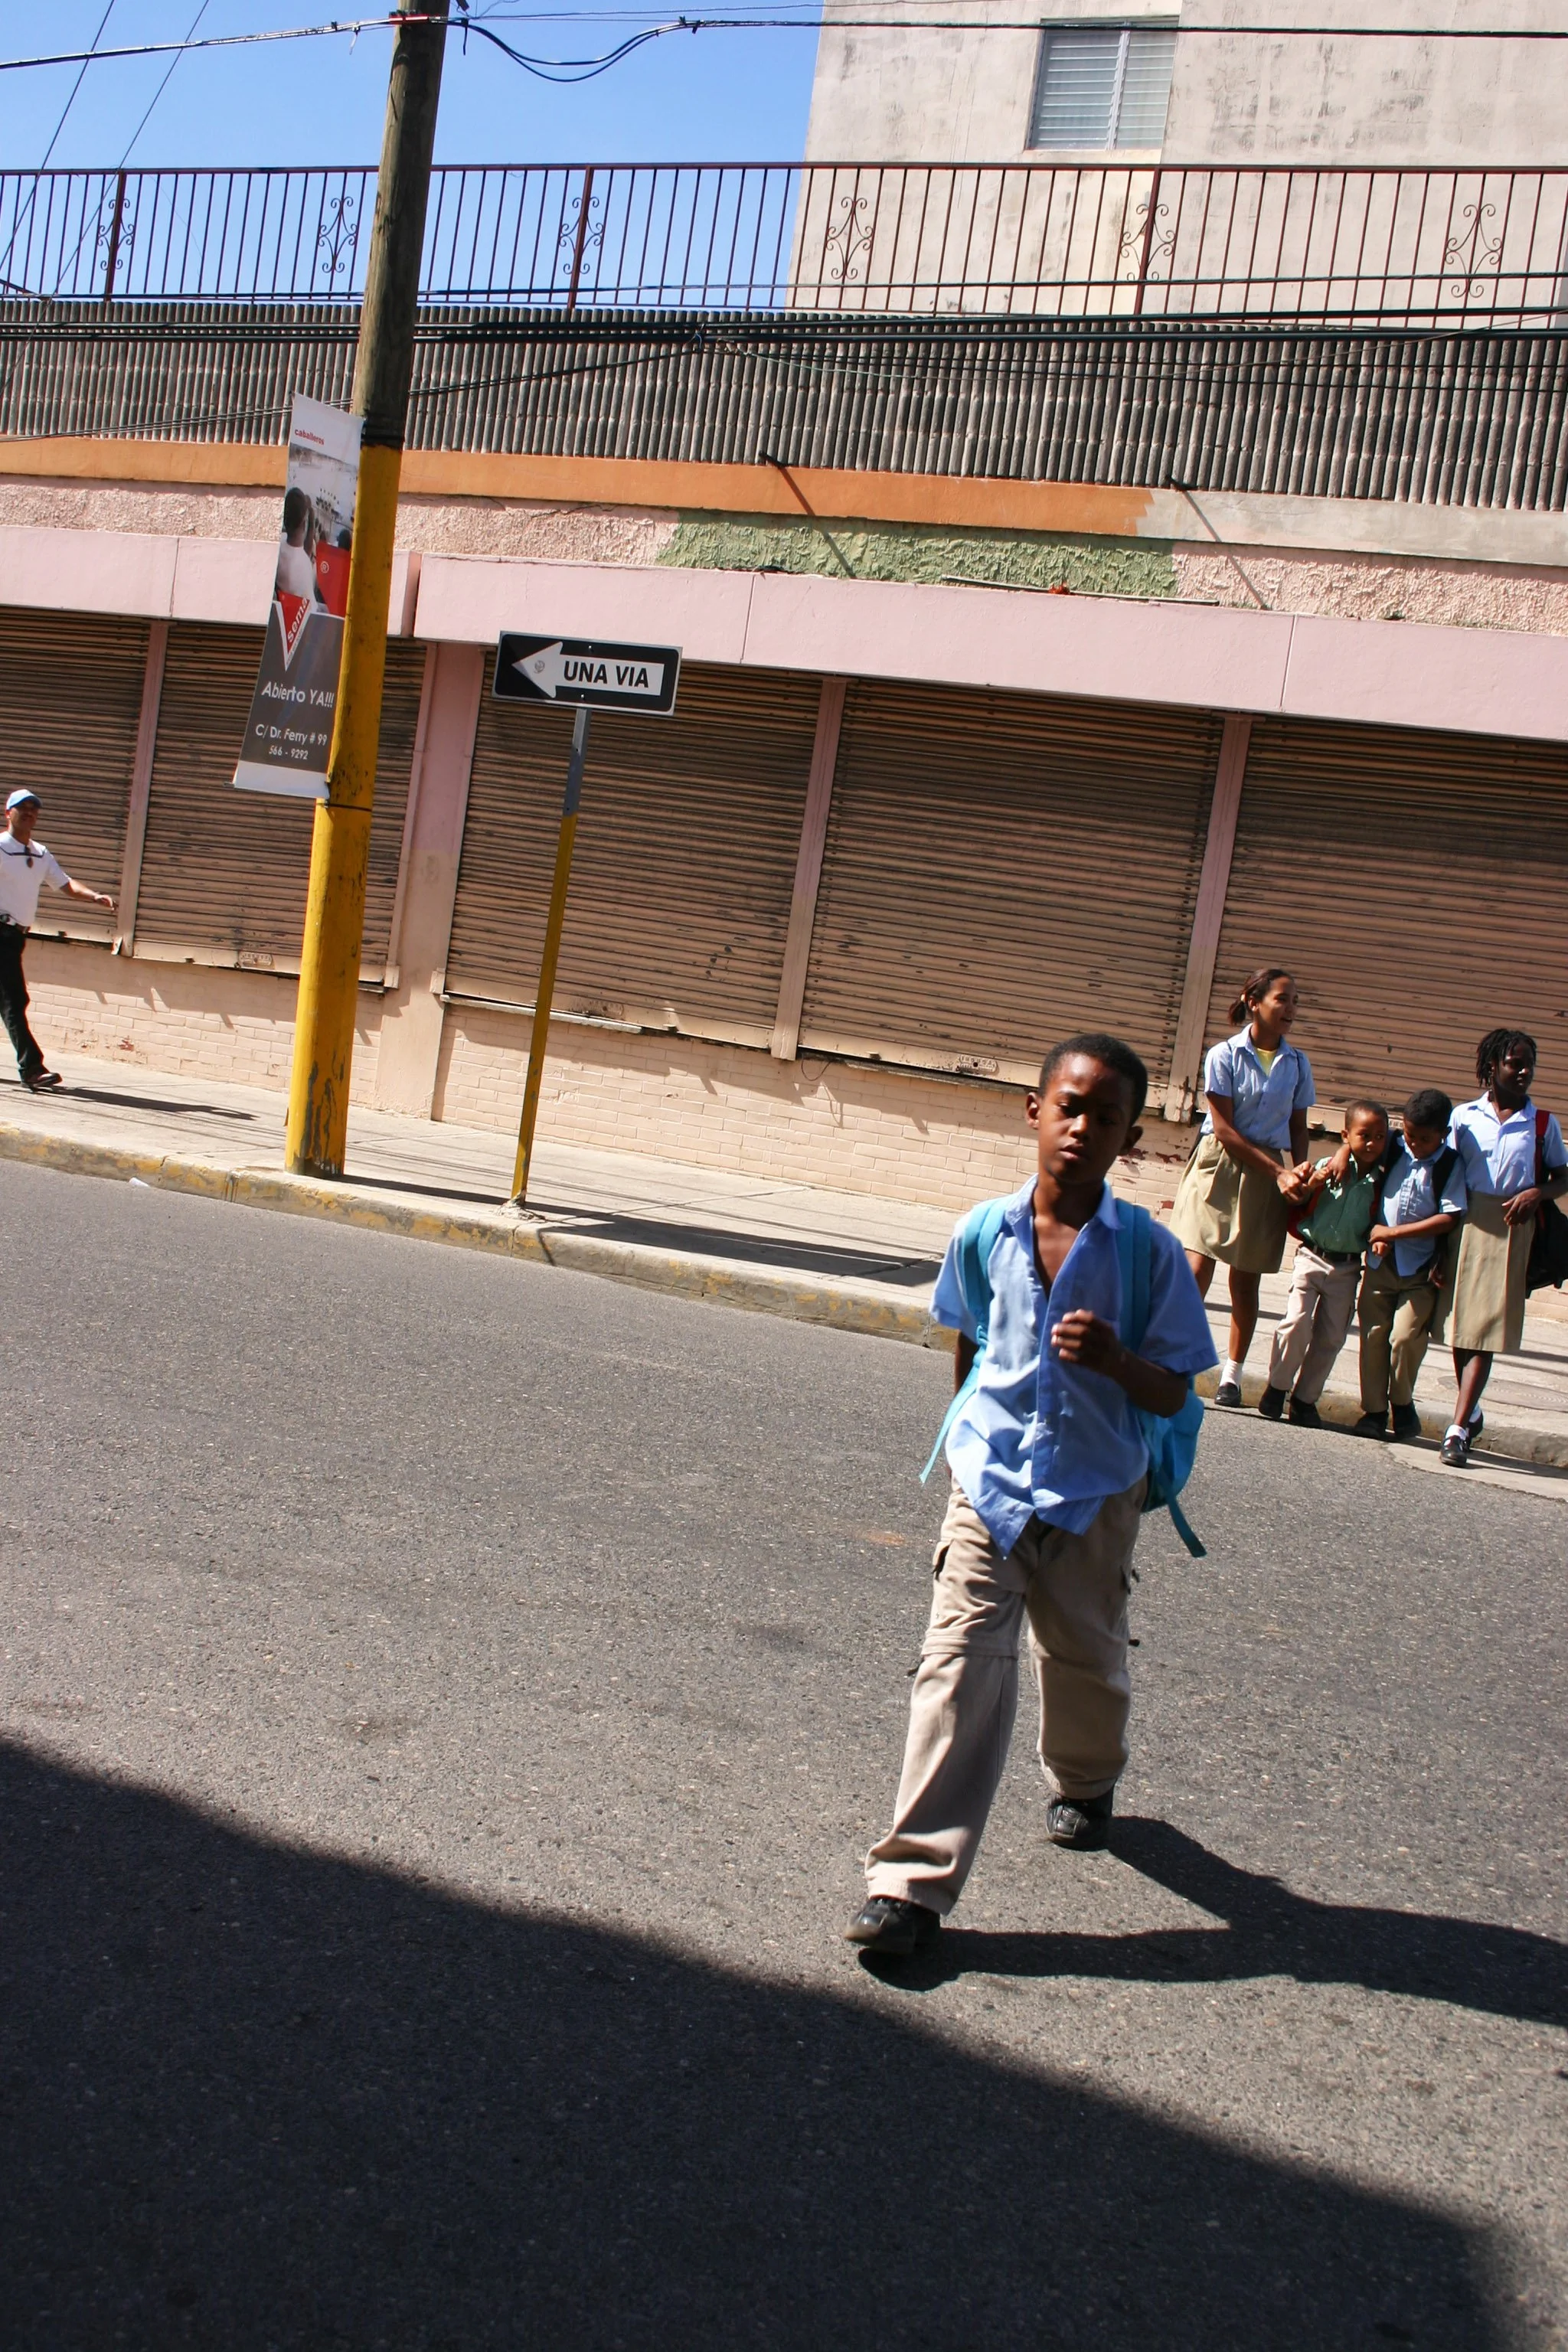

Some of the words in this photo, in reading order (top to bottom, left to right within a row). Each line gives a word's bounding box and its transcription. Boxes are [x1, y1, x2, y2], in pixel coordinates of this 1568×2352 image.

[295, 429, 325, 446] caballeros
[564, 660, 608, 684] UNA
[616, 665, 649, 688] VIA
[261, 681, 305, 703] Abierto
[309, 688, 335, 708] YA!!!
[255, 724, 269, 739] C/
[270, 726, 282, 739] Dr.
[284, 728, 308, 746] Ferry
[318, 733, 328, 746] 99
[269, 745, 283, 756] 566
[291, 748, 309, 760] 9292
